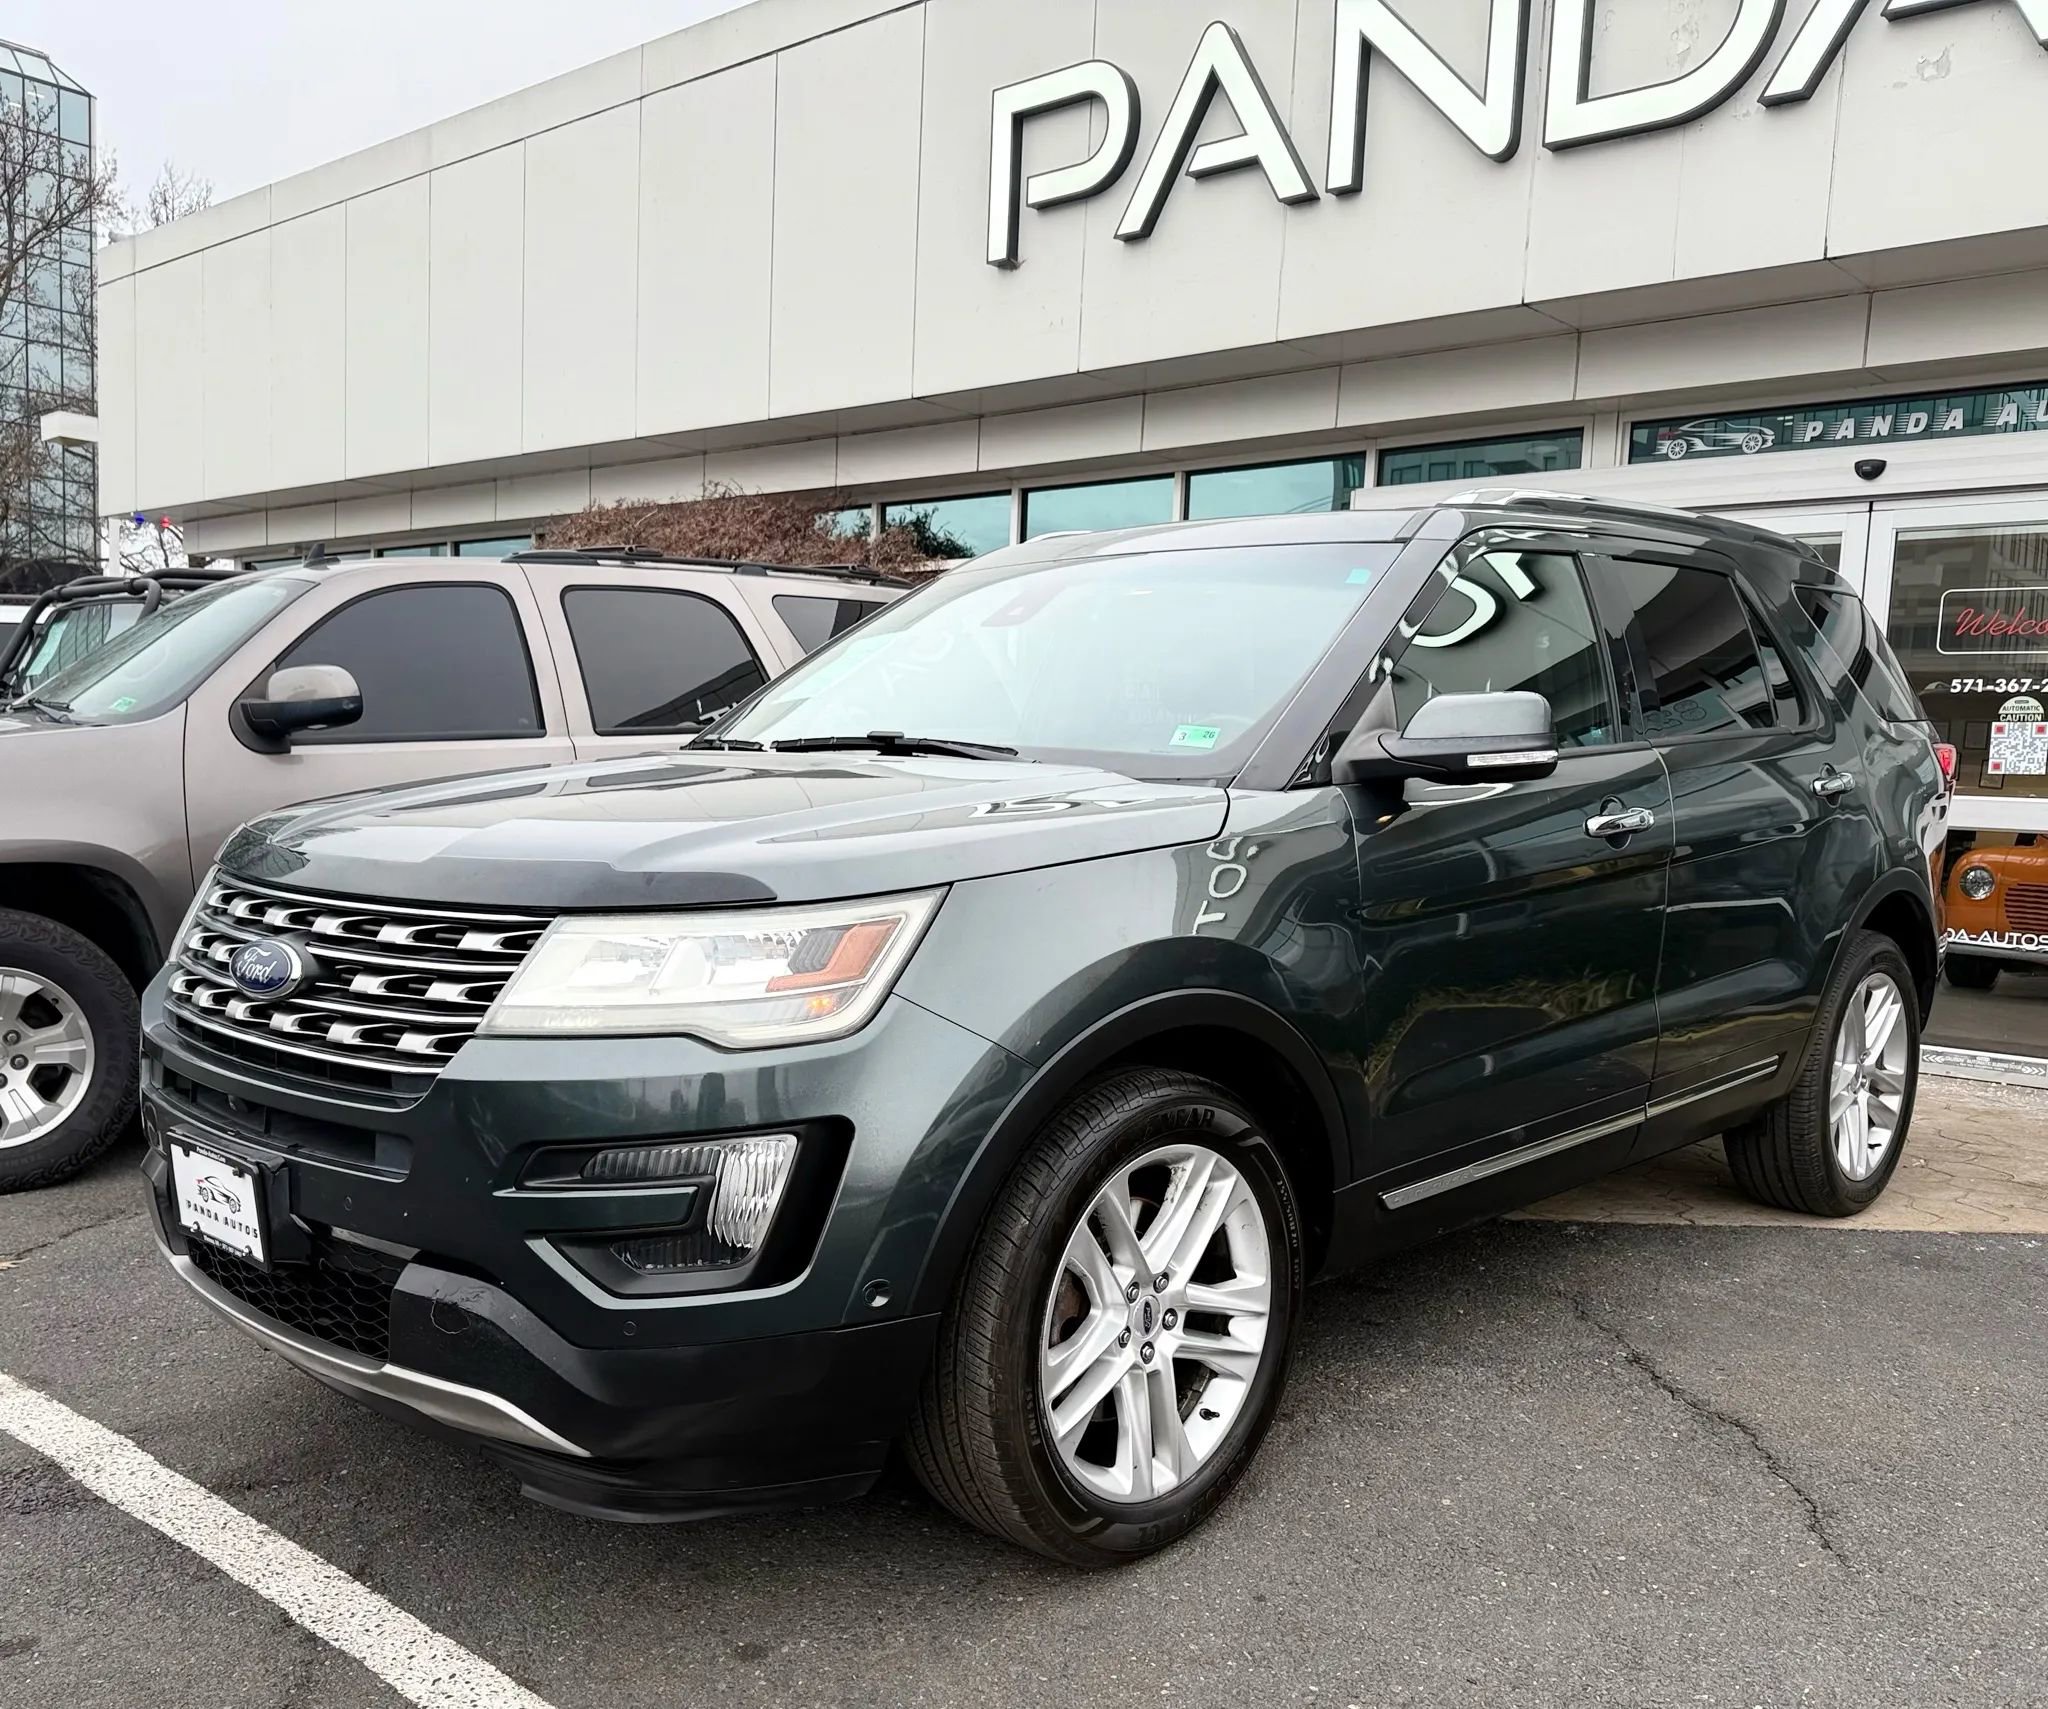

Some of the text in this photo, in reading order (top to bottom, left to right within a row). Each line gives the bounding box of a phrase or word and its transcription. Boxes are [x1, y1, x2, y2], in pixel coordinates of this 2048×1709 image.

[1793, 408, 1964, 443] PANDA
[1999, 713, 2042, 722] CAUTION
[1178, 732, 1187, 741] 3
[237, 947, 278, 984] Ford
[185, 1200, 259, 1239] PANDA AUTOS
